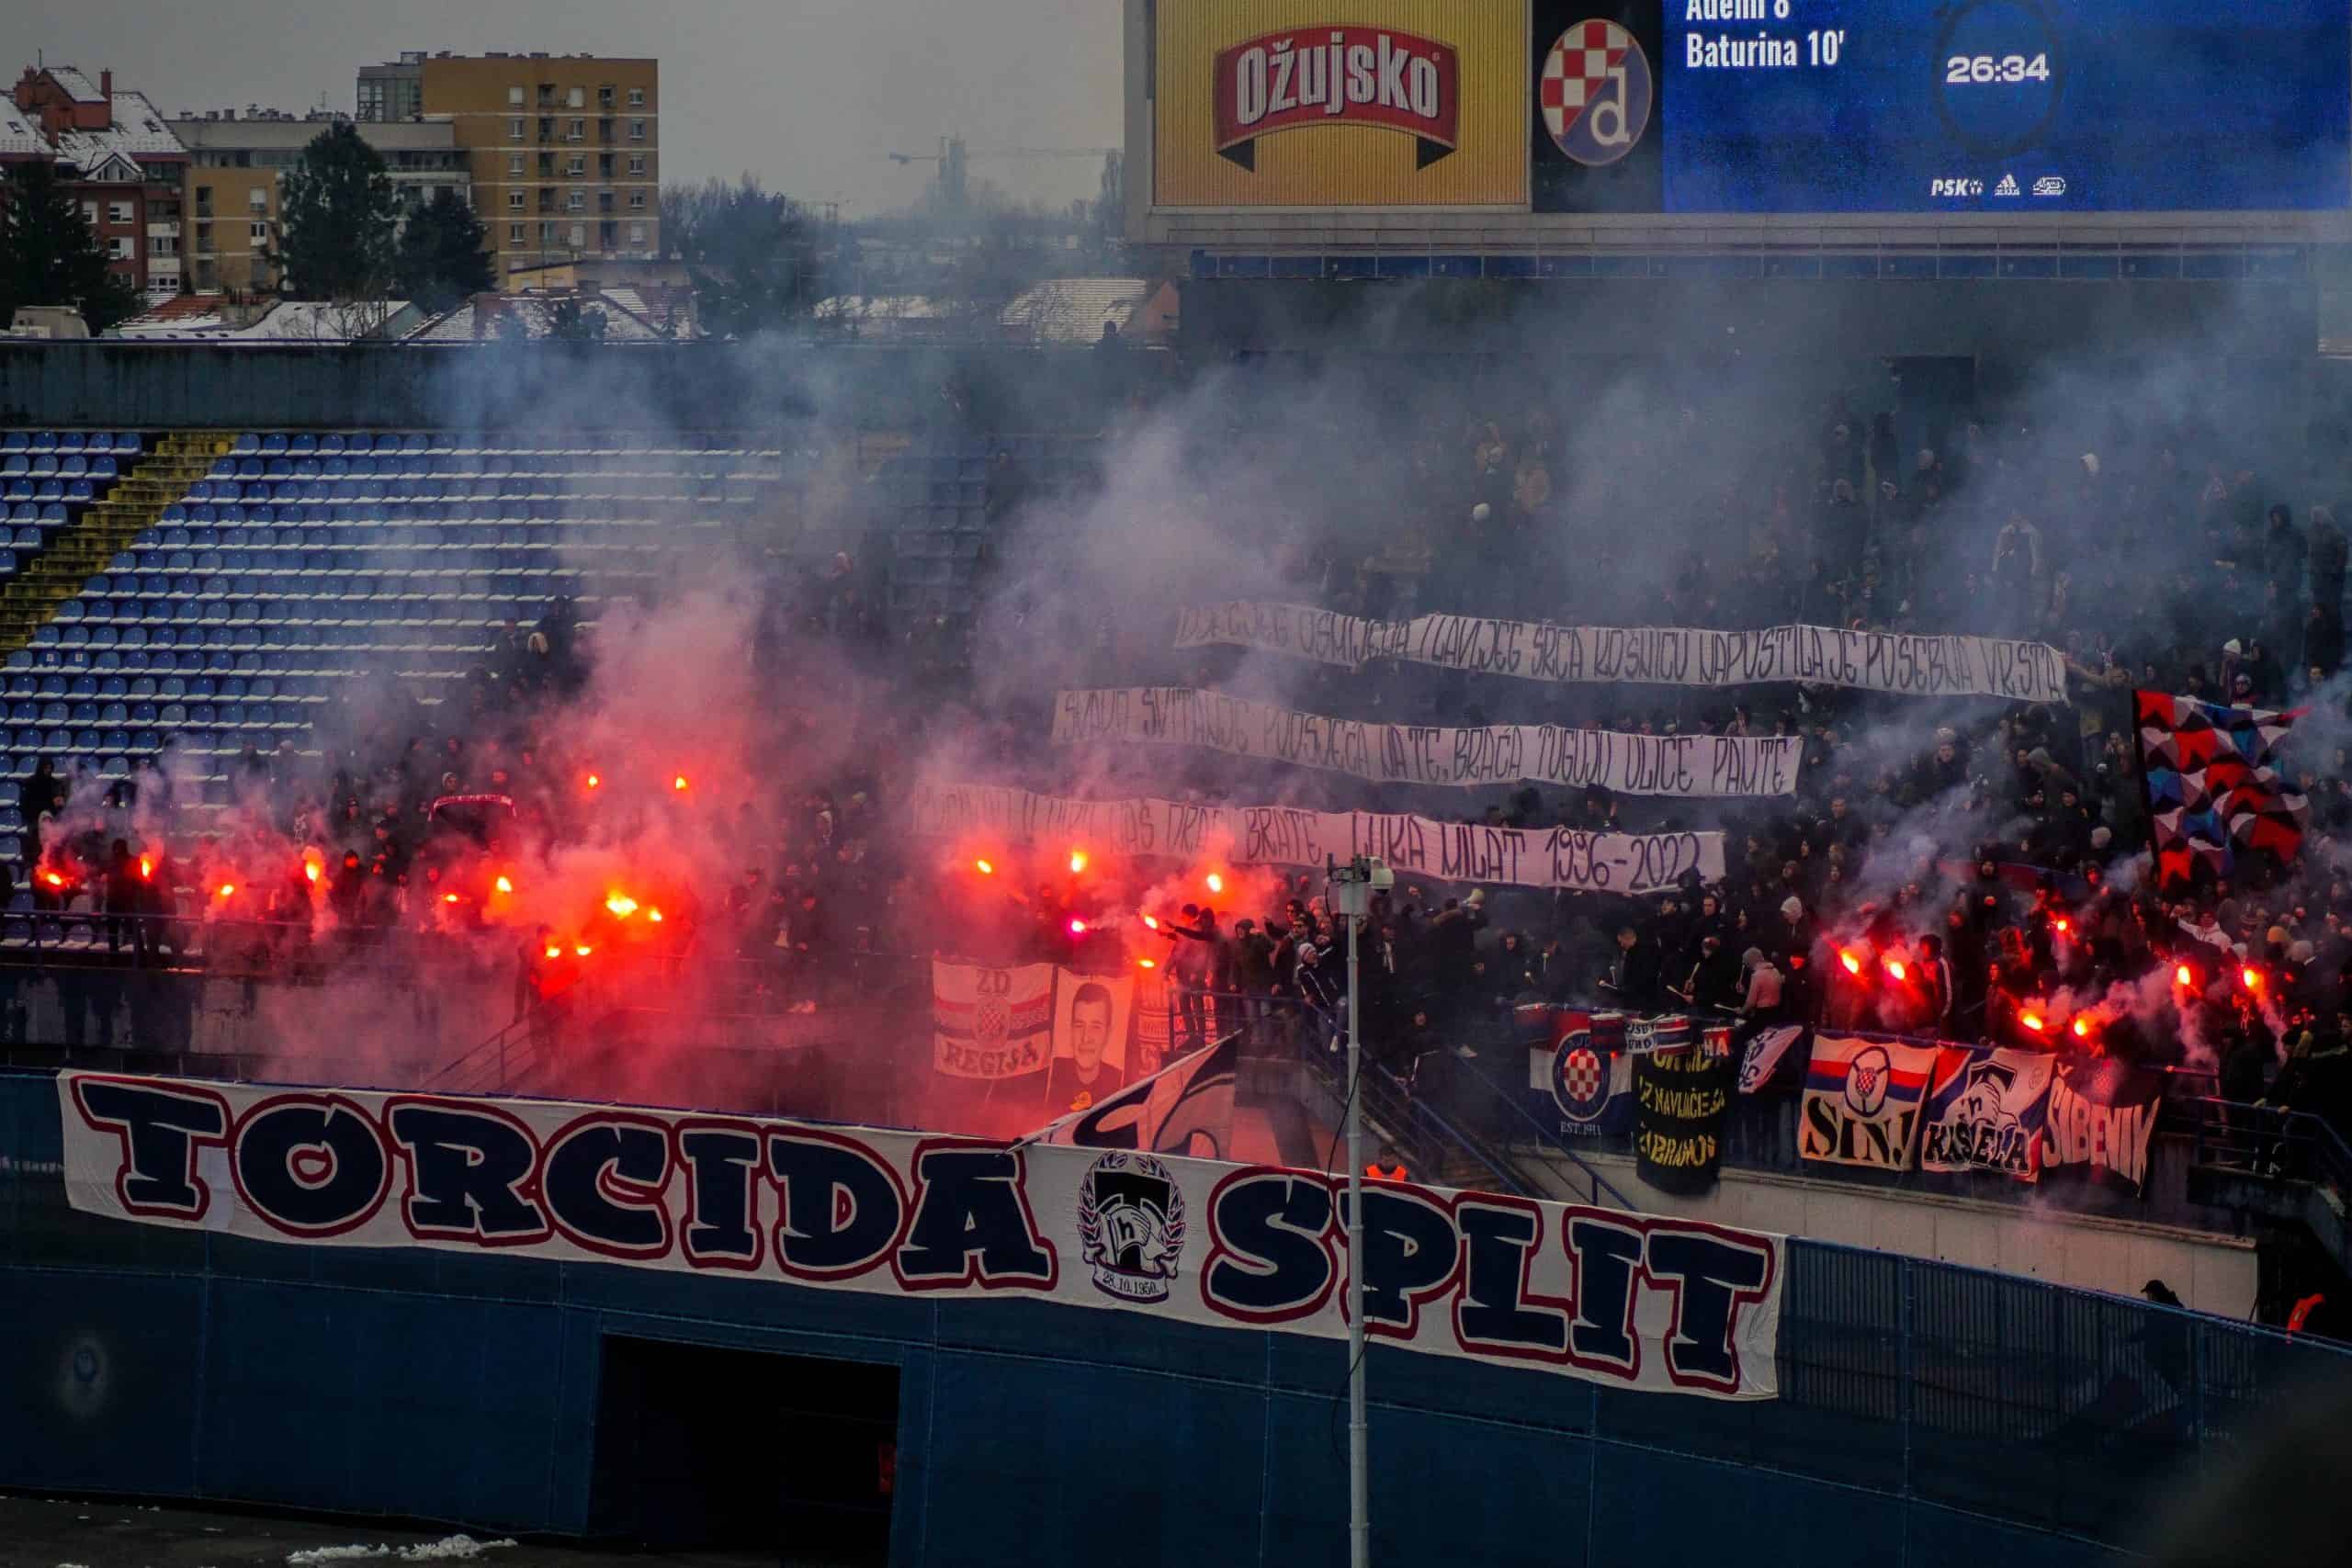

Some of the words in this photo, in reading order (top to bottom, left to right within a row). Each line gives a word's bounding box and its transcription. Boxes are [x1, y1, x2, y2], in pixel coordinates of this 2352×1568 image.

[1237, 31, 1440, 126] Ožujsko
[1686, 32, 1798, 69] Baturina
[1808, 29, 1846, 67] 10'
[1945, 55, 2051, 85] 26:34
[1532, 626, 1583, 679] SRCA
[1699, 624, 1824, 684] NAPUSTILA
[1830, 629, 1859, 685] JE
[1866, 635, 1973, 692] POSEBNA
[1537, 724, 1612, 785] TUGUJU
[1625, 734, 1694, 792] ULICE
[1245, 808, 1322, 866] BRATE
[1441, 820, 1526, 884] MILAT
[1544, 828, 1702, 892] 1996-2022
[70, 1075, 1059, 1292] TORCIDA
[1201, 1167, 1774, 1394] SPLIT
